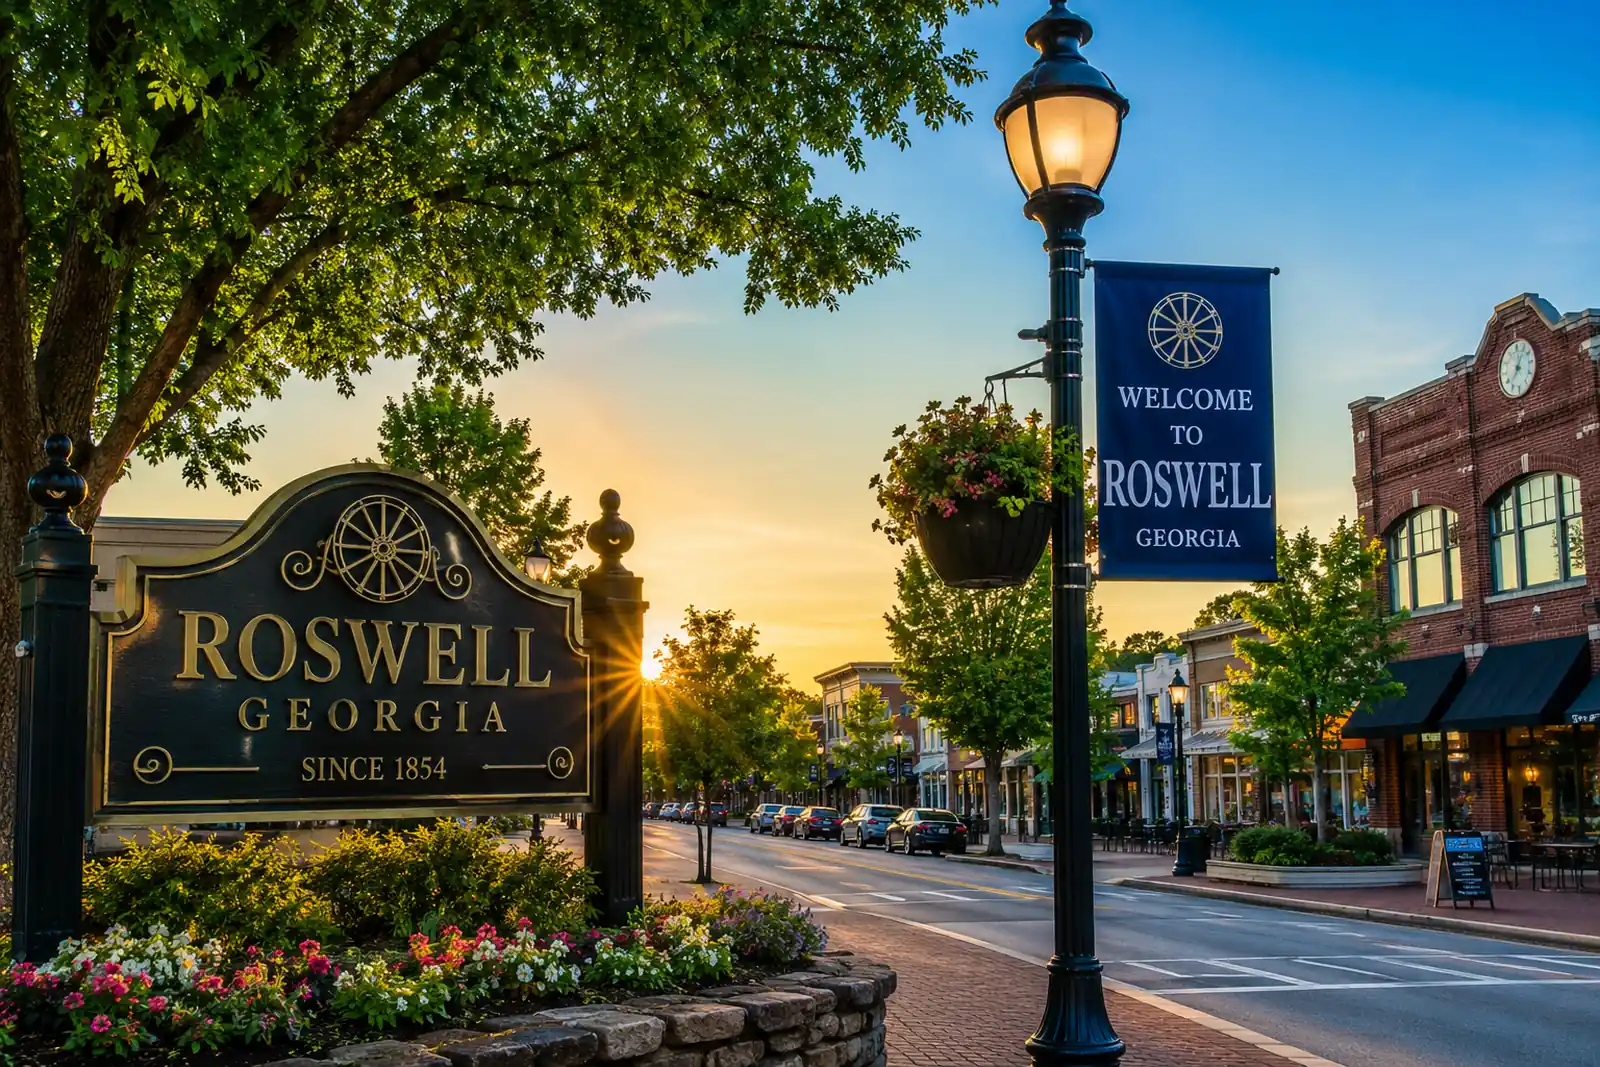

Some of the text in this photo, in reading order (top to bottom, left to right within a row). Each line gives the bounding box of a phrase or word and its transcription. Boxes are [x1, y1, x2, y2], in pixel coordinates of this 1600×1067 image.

[1118, 386, 1254, 411] WELCOME
[1170, 425, 1203, 446] TO
[1103, 459, 1272, 509] ROSWELL
[1136, 528, 1241, 548] GEORGIA
[176, 610, 552, 688] ROSWELL
[238, 697, 507, 733] GEORGIA
[301, 756, 447, 782] SINCE 1854
